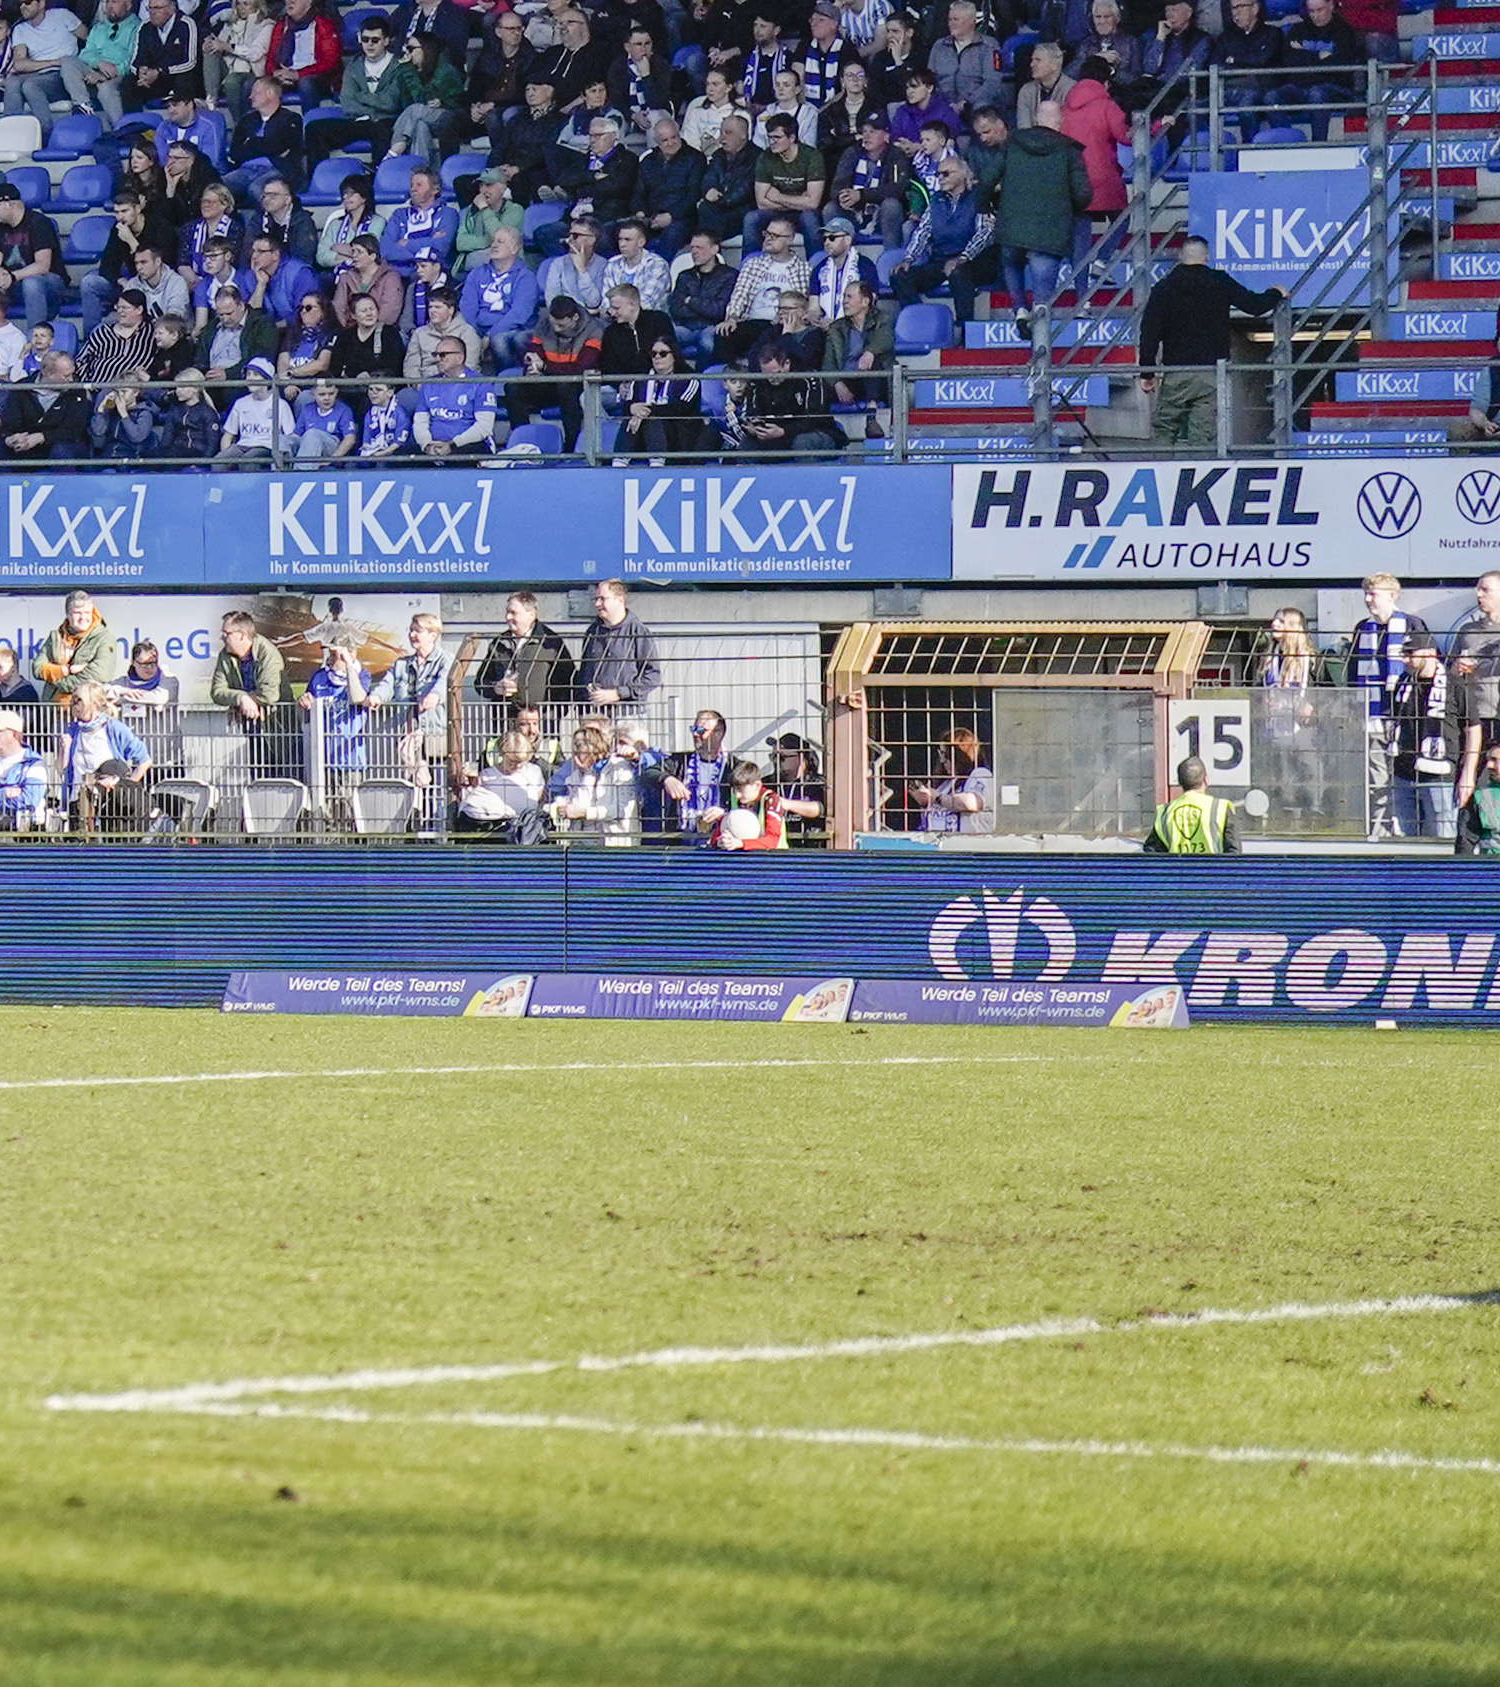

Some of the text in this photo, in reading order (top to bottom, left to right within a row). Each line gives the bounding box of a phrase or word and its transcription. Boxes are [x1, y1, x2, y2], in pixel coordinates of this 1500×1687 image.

[1405, 314, 1467, 335] KiKxxl
[935, 381, 995, 401] KiKxxl
[1357, 373, 1420, 394] KiKxxl
[269, 479, 494, 556] KiKxxl
[624, 476, 857, 554] KiKxxl
[623, 556, 643, 572] Ihr
[1117, 542, 1313, 568] AUTOHAUS
[269, 559, 490, 574] Ihr Kommunikationsdienstleister
[1176, 716, 1244, 770] 15
[289, 976, 466, 994] Werde Teil des Teams!
[599, 979, 784, 996] Werde Teil des Teams!
[340, 994, 460, 1009] www.pkf-wms.de
[921, 986, 1110, 1005] Werde Teil des Teams!
[654, 998, 779, 1013] www.pkf-wms.de
[977, 1003, 1105, 1019] www.pkf-wms.de
